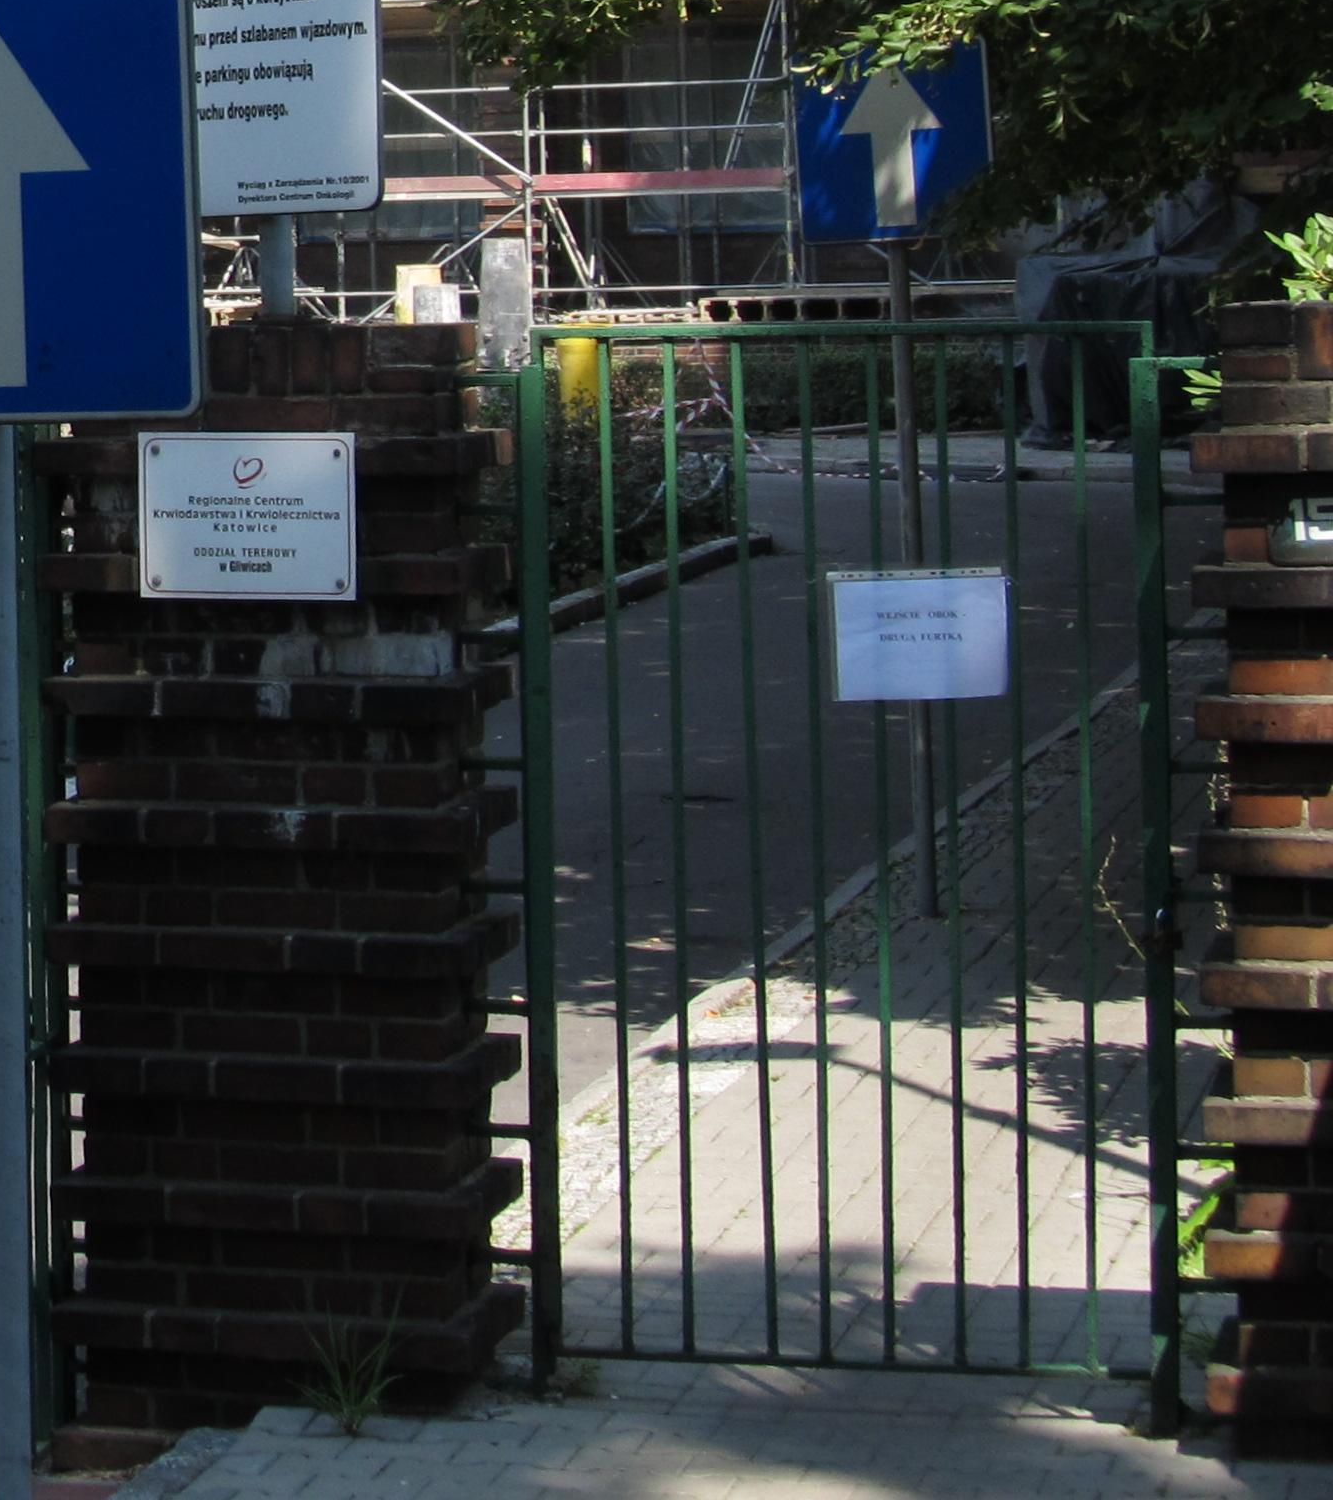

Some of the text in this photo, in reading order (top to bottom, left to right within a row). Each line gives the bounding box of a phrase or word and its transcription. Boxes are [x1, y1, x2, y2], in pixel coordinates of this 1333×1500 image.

[208, 25, 238, 50] przed
[241, 22, 297, 44] szlabanem
[300, 19, 367, 44] wjazdowym.
[205, 65, 250, 86] parkingu
[253, 57, 313, 83] obowiązują
[228, 101, 288, 122] drogowego.
[279, 192, 314, 202] Centrum
[187, 495, 304, 508] Regionalne Centrum
[153, 508, 236, 521] Krwiodawstwa
[245, 509, 341, 521] Krwiolecznictwa
[213, 522, 278, 533] Katowice
[193, 547, 297, 558] ODDZIAŁ TERENOWY
[219, 561, 273, 573] w Gliwicach
[927, 609, 958, 620] OBOK
